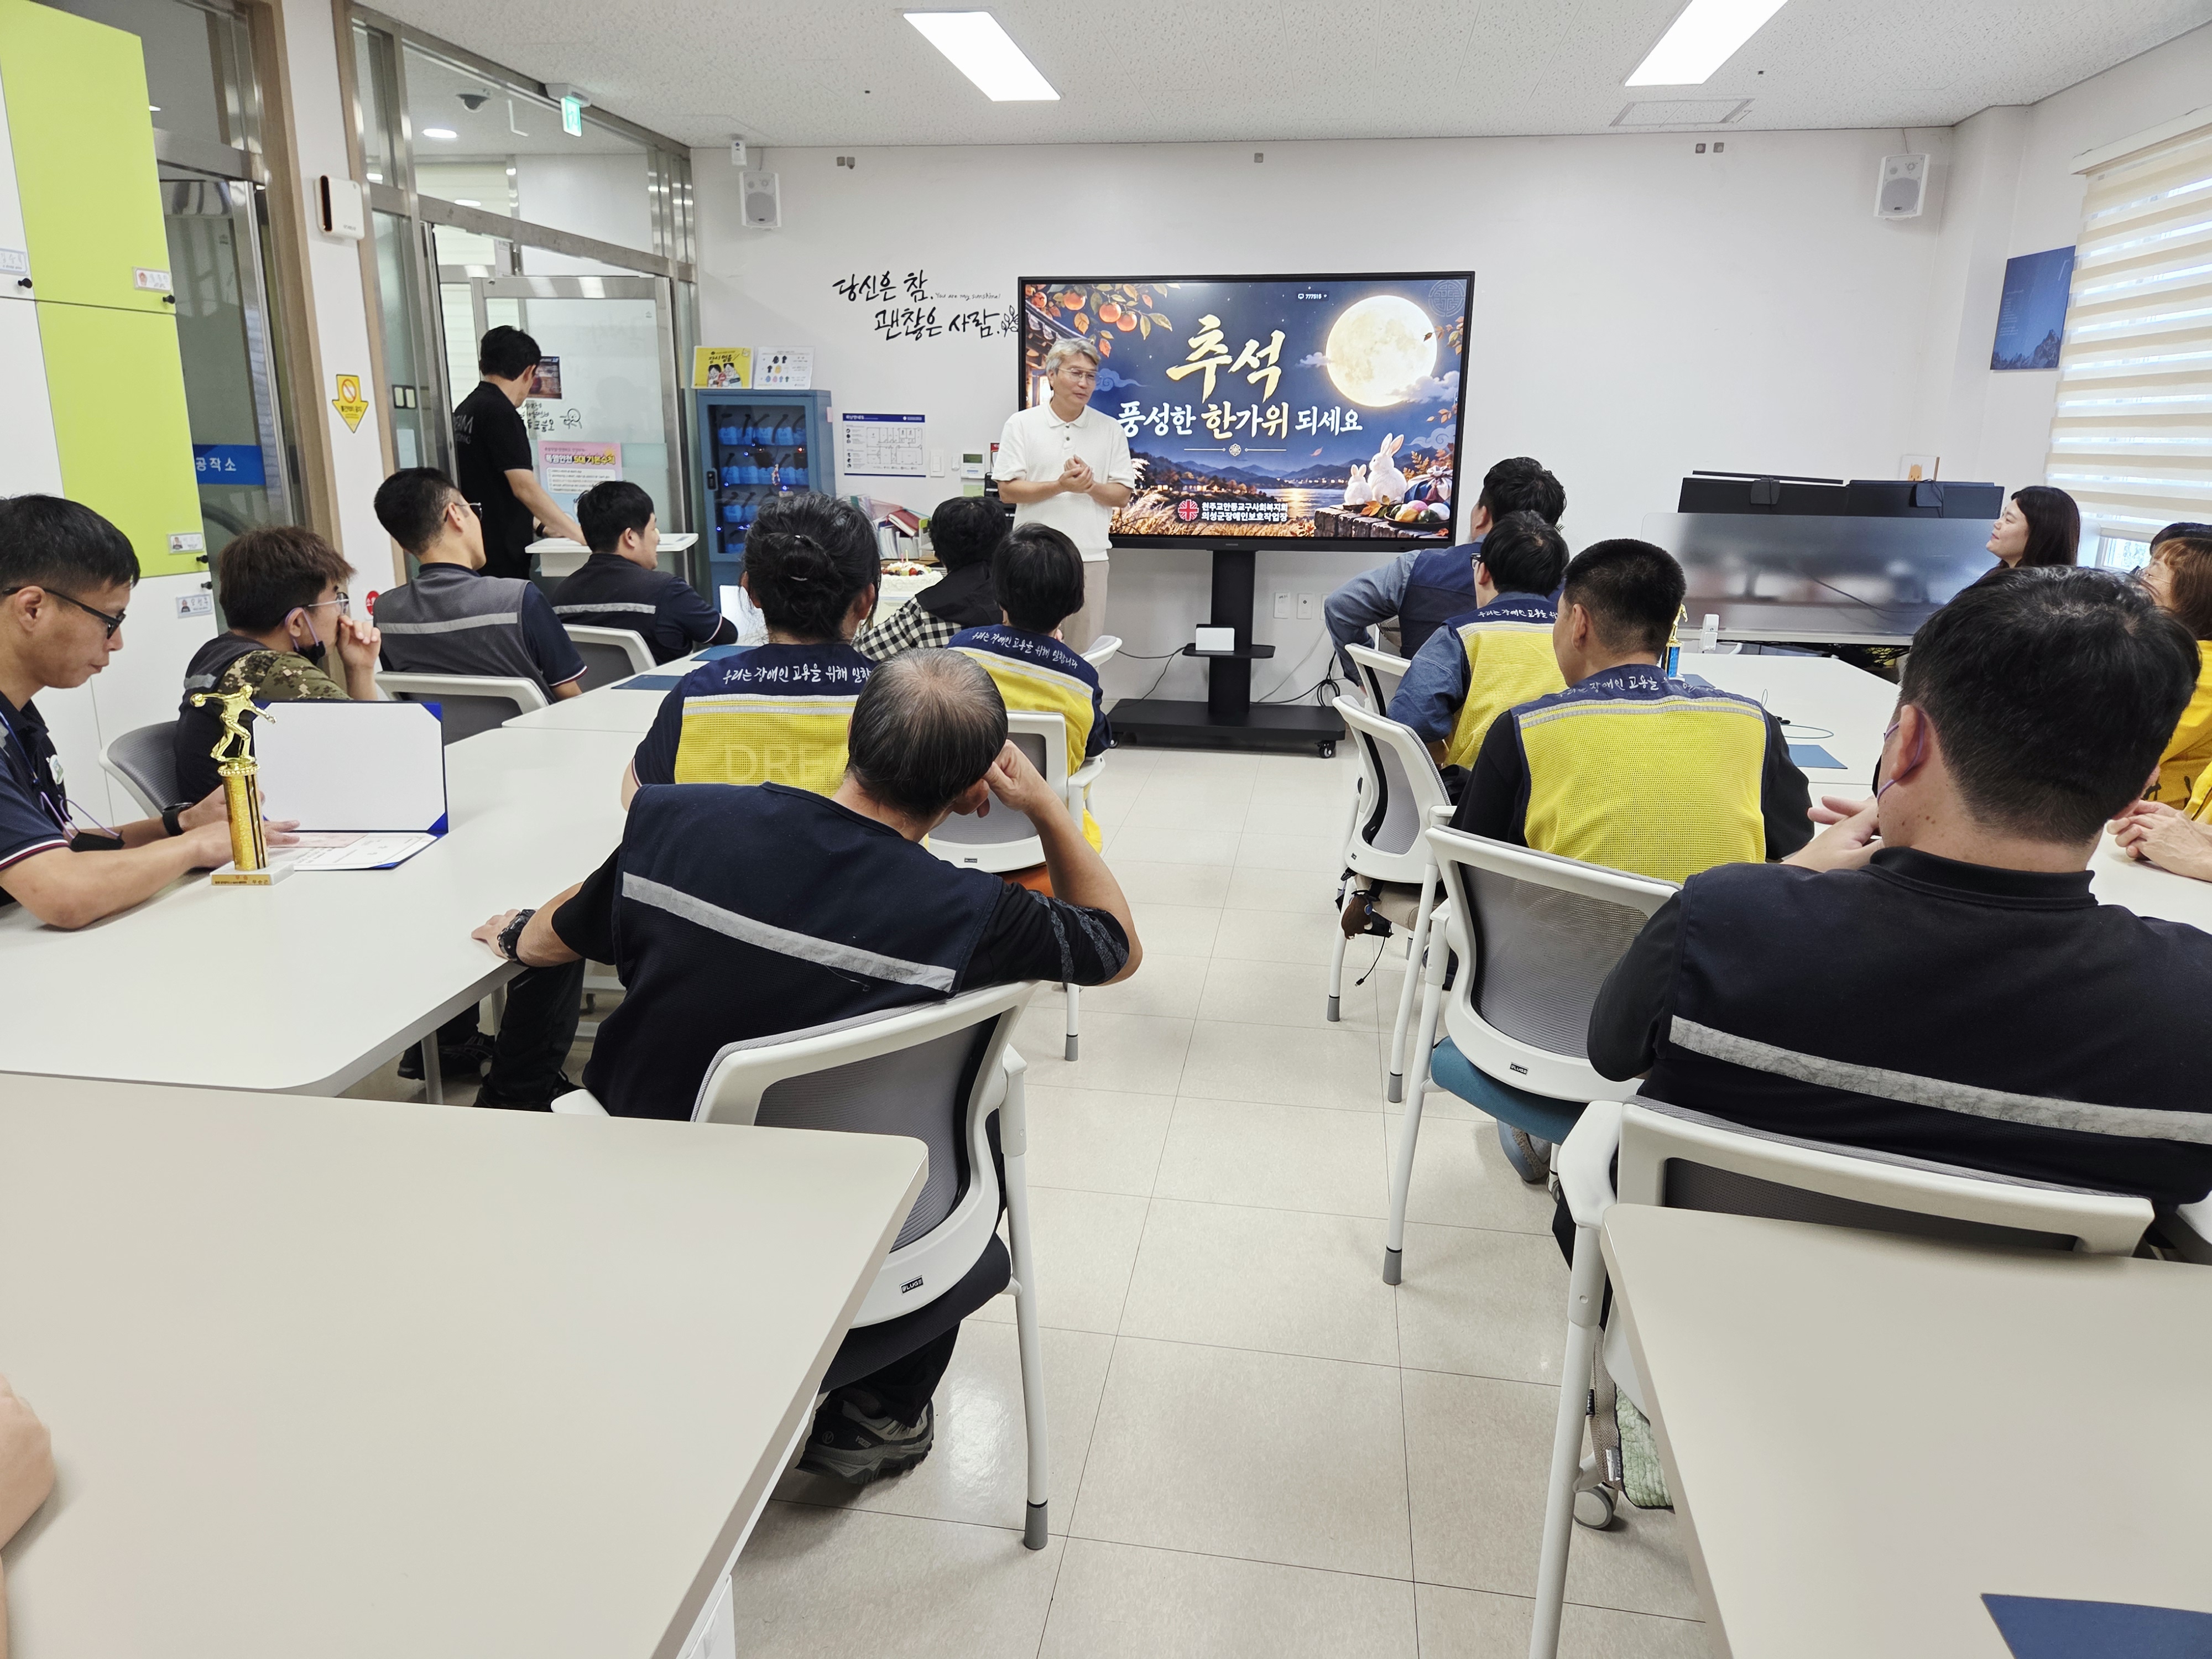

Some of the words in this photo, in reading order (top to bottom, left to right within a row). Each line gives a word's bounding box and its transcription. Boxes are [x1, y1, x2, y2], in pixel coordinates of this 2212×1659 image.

[832, 270, 896, 301] 당신은
[874, 307, 942, 341] 괜찮은
[1166, 314, 1286, 404] 추석
[1117, 400, 1197, 438] 풍성한
[1201, 400, 1289, 440] 한가위
[1295, 405, 1363, 436] 되세요
[195, 457, 237, 472] 공작소
[573, 455, 586, 465] 5대
[1501, 609, 1527, 617] 장애인
[1527, 608, 1548, 619] 고용을
[972, 632, 990, 642] 우리는
[990, 633, 1012, 648] 장애인
[1012, 638, 1034, 654] 고용을
[1035, 645, 1050, 659] 위해
[1052, 649, 1078, 669] 일합니다
[722, 668, 753, 685] 우리는
[754, 665, 790, 683] 장애인
[792, 662, 822, 683] 고용을
[825, 665, 848, 683] 위해
[1589, 678, 1625, 693] 장애인
[1629, 675, 1660, 691] 고용을
